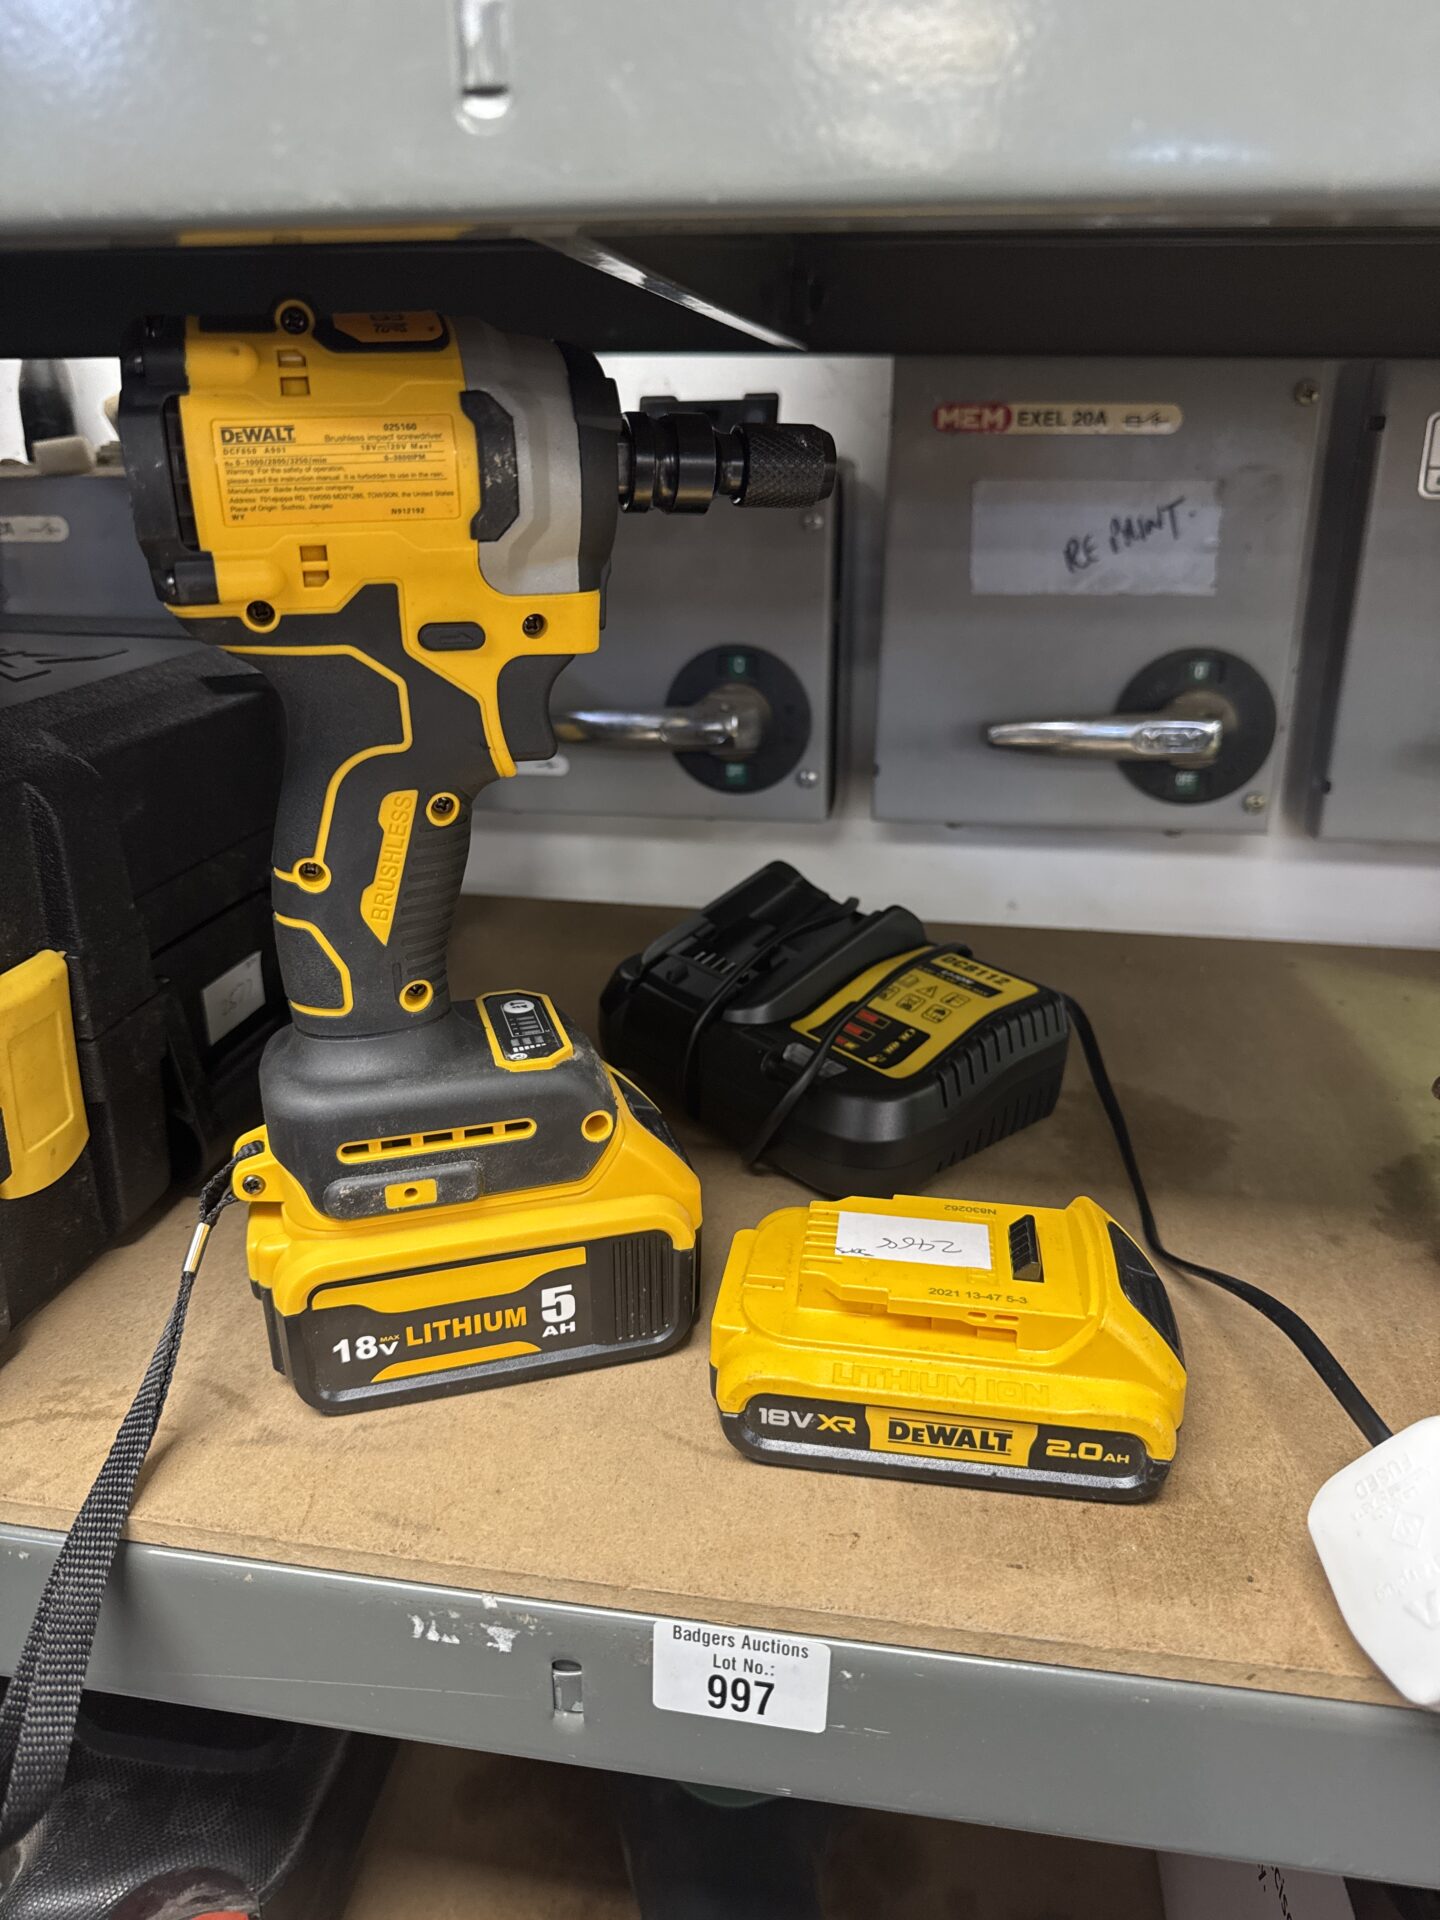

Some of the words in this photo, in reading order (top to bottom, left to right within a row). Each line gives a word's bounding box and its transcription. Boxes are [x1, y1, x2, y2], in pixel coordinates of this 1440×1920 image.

[937, 407, 1006, 429] MEM
[1017, 411, 1066, 427] EXEL
[1072, 410, 1107, 426] 20A
[324, 434, 365, 442] Brushless
[367, 433, 394, 441] impact
[396, 432, 442, 440] screwdriver
[1063, 535, 1100, 574] RE
[371, 795, 412, 921] BRUSHLESS
[944, 1204, 997, 1216] N830262
[928, 1287, 960, 1298] 2021
[405, 1306, 527, 1347] LITHIUM
[541, 1284, 576, 1323] 5
[379, 1334, 400, 1343] MAX
[541, 1322, 576, 1338] AH
[832, 1362, 977, 1403] LITHIUM
[986, 1378, 1050, 1406] ION
[758, 1407, 813, 1428] 18V
[816, 1413, 857, 1434] XR
[1354, 1453, 1412, 1499] FUSED
[673, 1625, 735, 1647] Badgers
[741, 1635, 809, 1659] Auctions
[713, 1653, 736, 1671] Lot
[744, 1658, 775, 1677] No.:
[708, 1674, 775, 1715] 997
